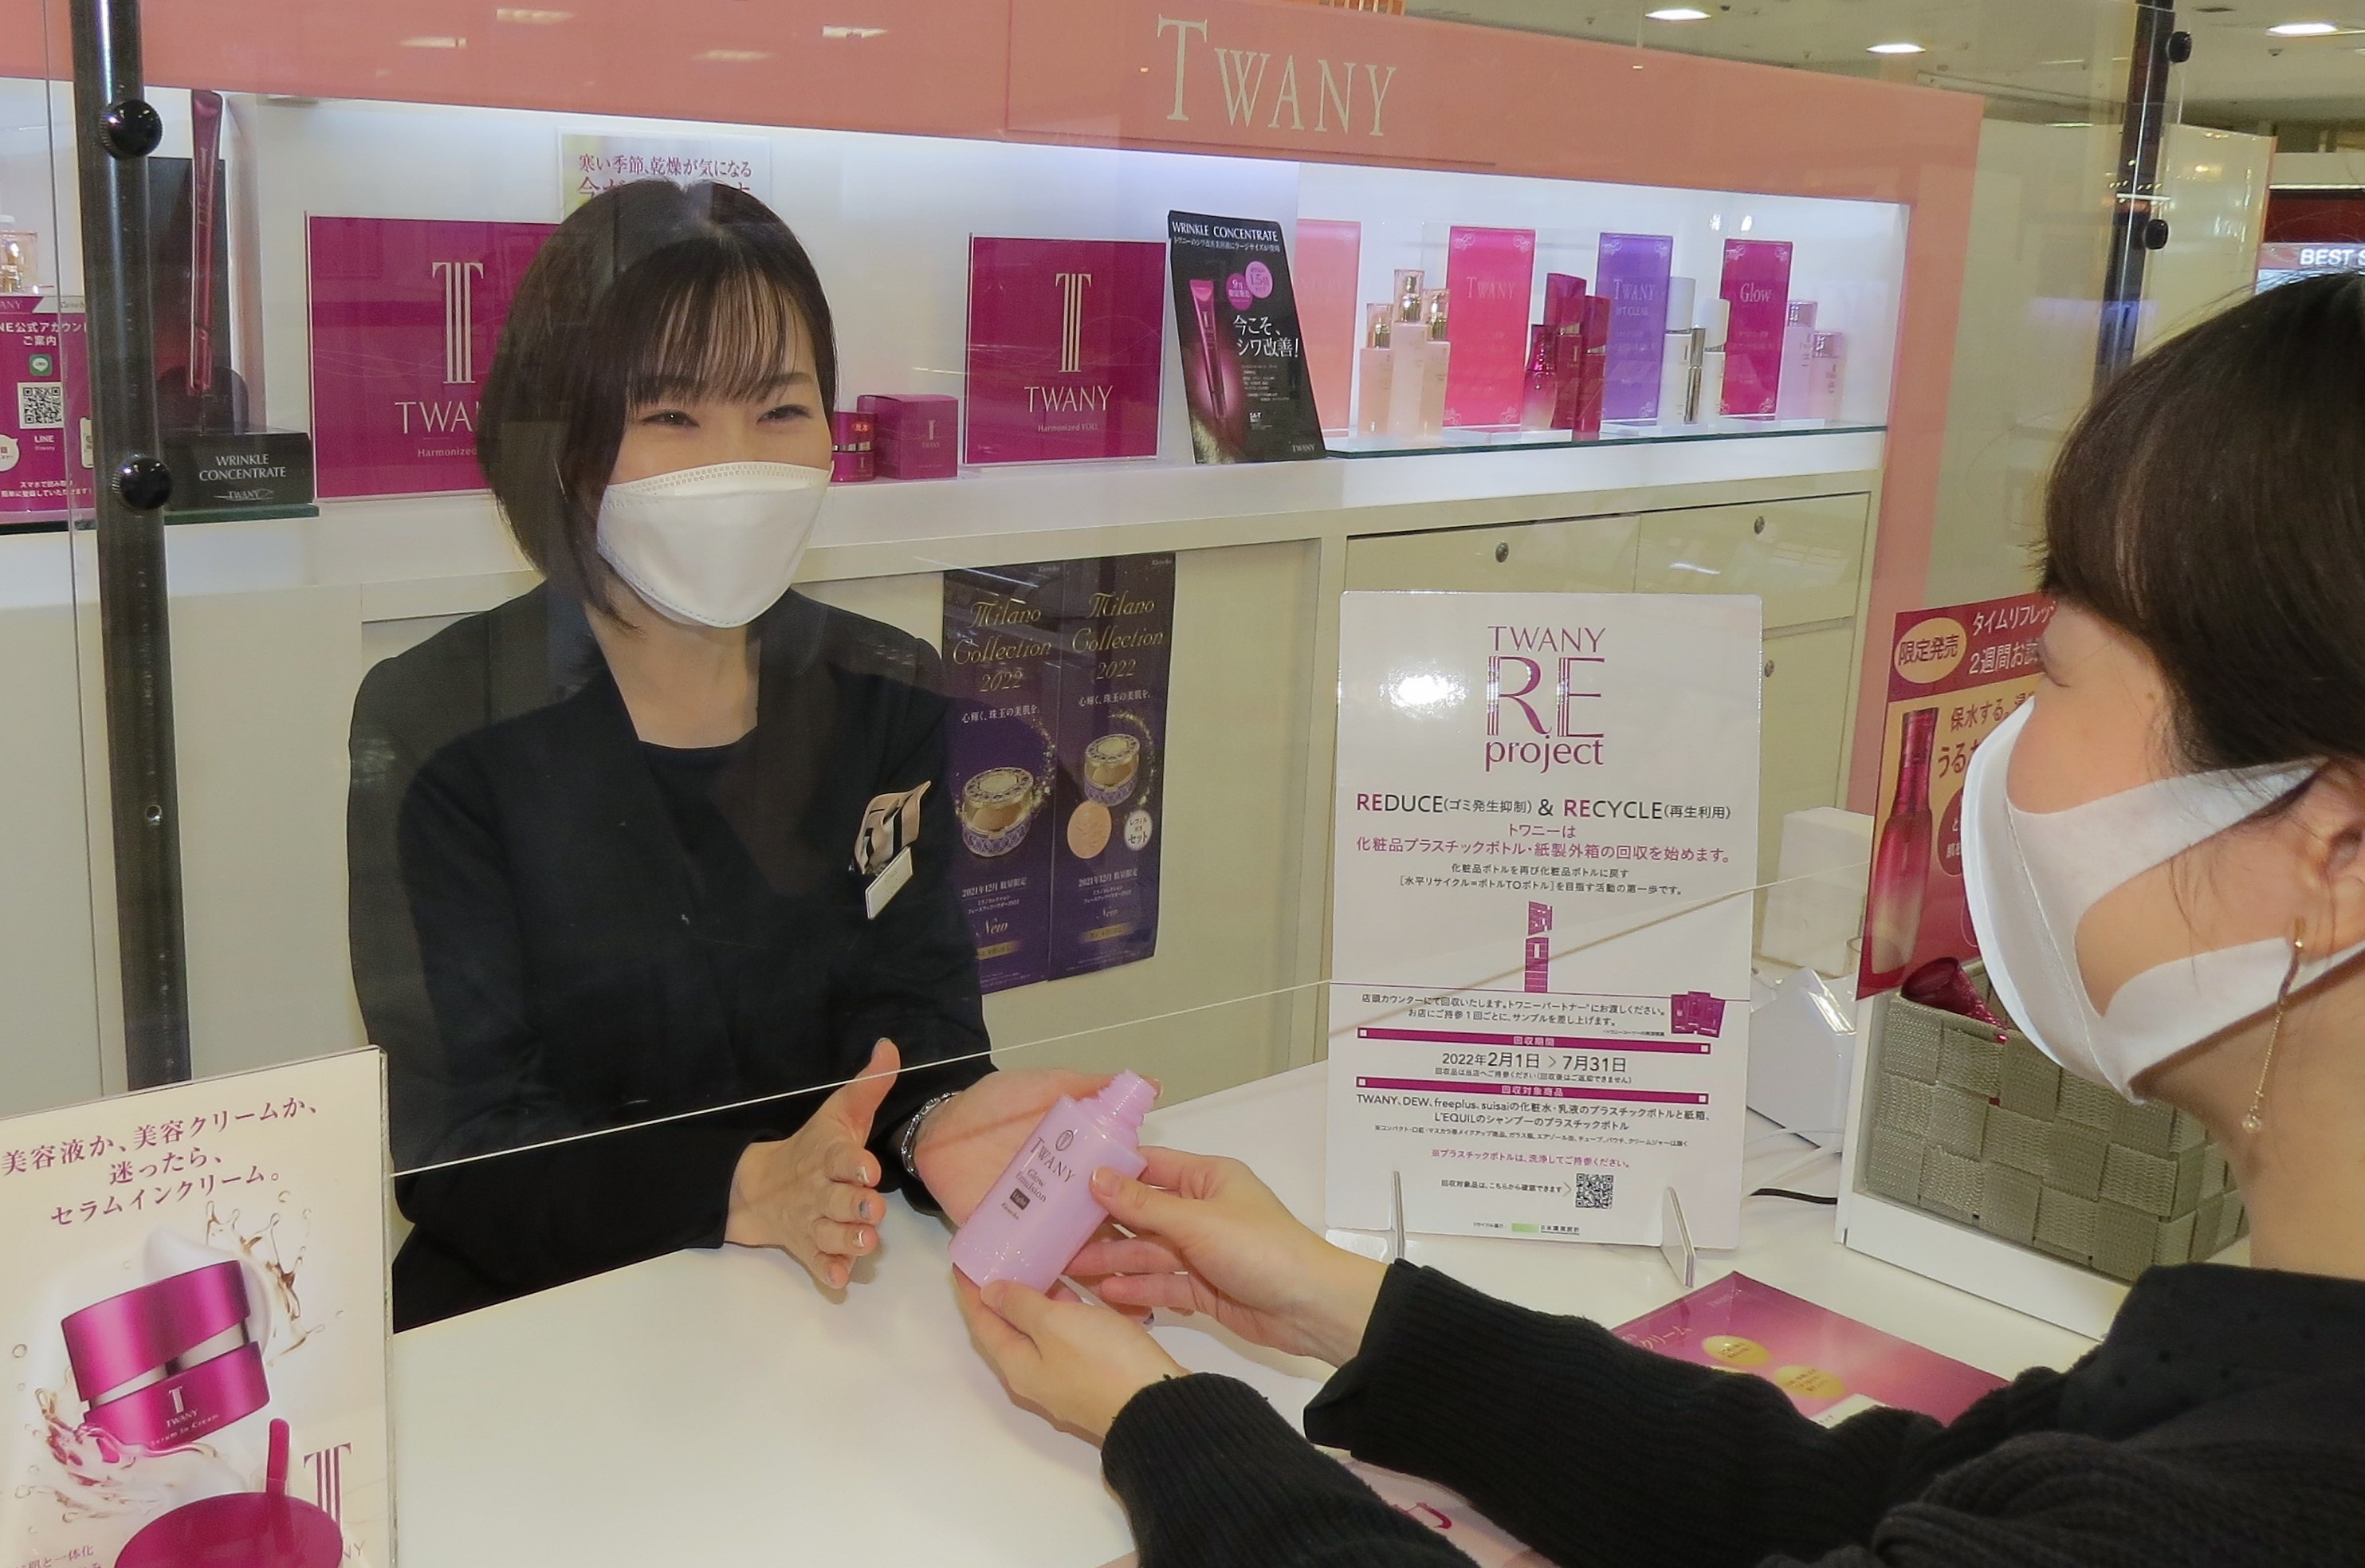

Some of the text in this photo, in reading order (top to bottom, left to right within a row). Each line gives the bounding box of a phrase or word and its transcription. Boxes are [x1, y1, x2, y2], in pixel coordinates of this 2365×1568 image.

[579, 154, 752, 178] 寒い季節、乾燥が気になる
[1172, 222, 1279, 242] WRINKLE CONCENTRATE
[2300, 248, 2355, 266] BEST
[1739, 283, 1773, 304] Glow
[1233, 315, 1281, 336] 今こそ、
[23, 335, 57, 347] ご案内
[1023, 385, 1113, 413] TWANY
[395, 401, 483, 434] TWA
[1038, 424, 1080, 433] Harmonized
[34, 434, 55, 443] LINE
[216, 454, 269, 466] WRINKLE
[199, 466, 287, 481] CONCENTRATE
[969, 600, 1042, 629] Milano
[1086, 590, 1155, 619] Milano
[953, 635, 1052, 665] Collection
[1071, 626, 1164, 654] Collection
[1487, 626, 1606, 653] TWANY
[1898, 635, 1960, 666] 限定発売
[1095, 658, 1137, 680] 2022
[979, 670, 1024, 693] 2022
[1487, 655, 1606, 738] RE
[1485, 734, 1605, 774] project
[1538, 799, 1554, 817] &
[1128, 831, 1149, 844] セット
[1508, 823, 1577, 839] トワニーは
[1357, 837, 1730, 863] 化粧品プラスチックボトル・紙製外箱の回収を始めます。
[1452, 863, 1629, 878] 化粧品ボトルを再び化粧品ボトルに戻す
[1514, 1036, 1554, 1046] 回収期間
[1442, 1051, 1626, 1073] 2022年2月1日 7月31日
[1502, 1086, 1563, 1097] 回収対象商品
[1, 1097, 318, 1177] 美容液か、美容クリームか、
[108, 1147, 223, 1186] 迷ったら、
[1031, 1137, 1076, 1183] TWANY
[1016, 1171, 1047, 1202] Emulsion
[1027, 1169, 1046, 1187] Glow
[51, 1165, 280, 1226] セラムインクリーム。
[166, 1408, 198, 1428] TWANY
